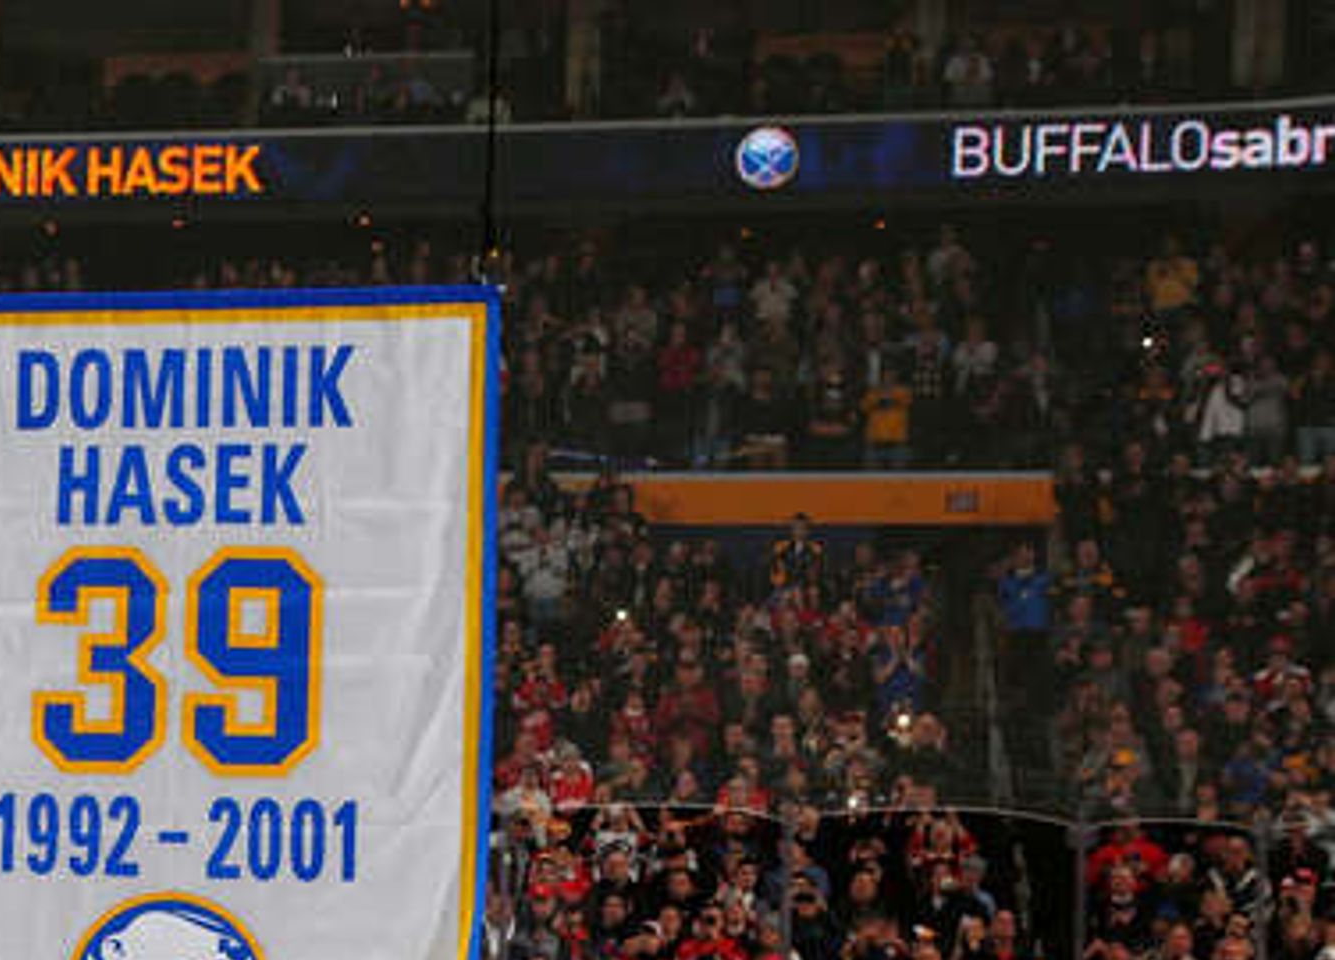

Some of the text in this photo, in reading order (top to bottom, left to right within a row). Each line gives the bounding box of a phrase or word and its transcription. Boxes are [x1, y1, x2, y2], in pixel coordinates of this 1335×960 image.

[85, 144, 263, 195] HASEK
[15, 343, 355, 430] DOMINIK
[56, 441, 307, 527] HASEK
[31, 545, 325, 779] 39
[205, 796, 358, 883] 2001
